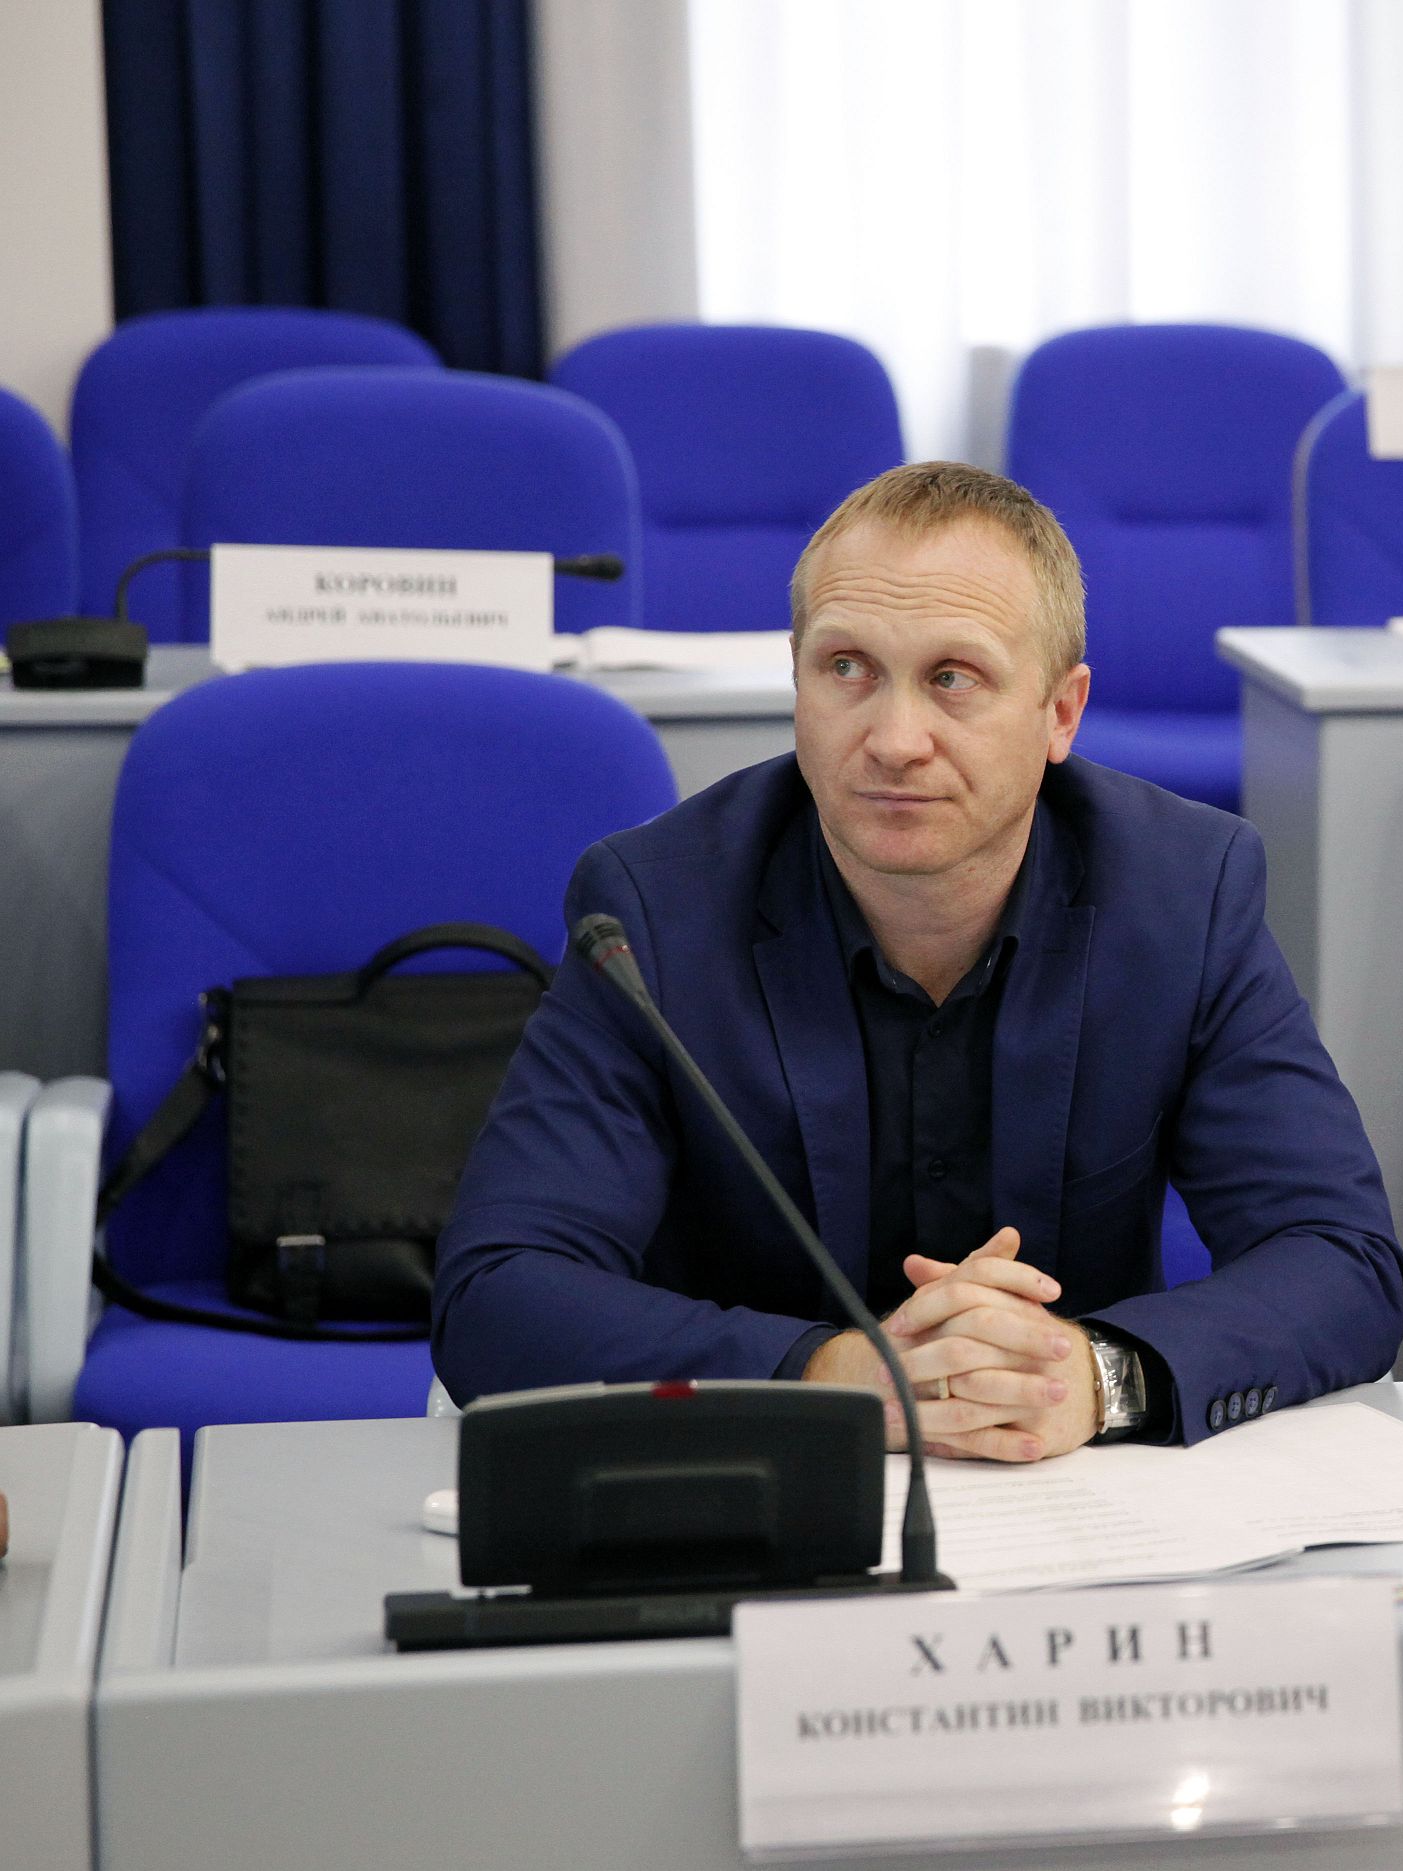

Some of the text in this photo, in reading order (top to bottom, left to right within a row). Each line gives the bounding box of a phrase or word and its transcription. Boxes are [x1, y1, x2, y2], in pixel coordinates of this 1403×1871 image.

[314, 571, 458, 597] КОРОВИН
[909, 1619, 1214, 1676] ХАРИН
[796, 1683, 1331, 1742] КОНСТАНТИН ВИКТОРОВИЧ
